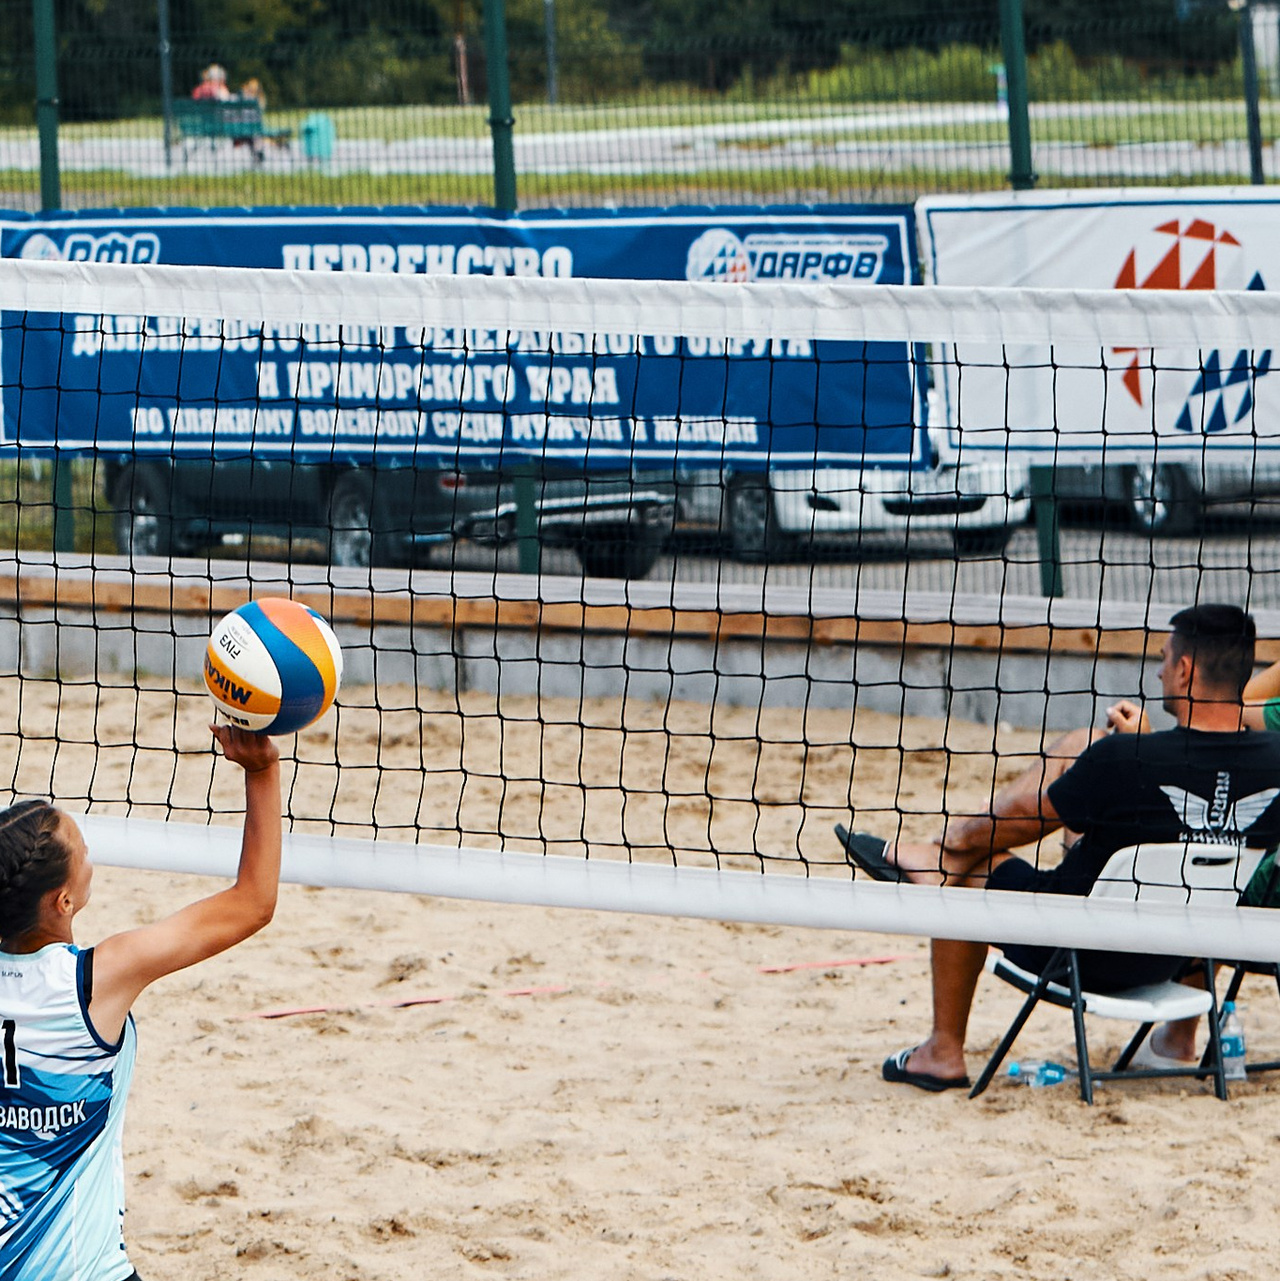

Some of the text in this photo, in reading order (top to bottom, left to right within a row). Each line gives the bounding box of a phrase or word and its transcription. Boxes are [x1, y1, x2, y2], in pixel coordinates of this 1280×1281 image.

[286, 361, 517, 403] ПРИМОРСКОГО
[525, 365, 620, 404] КРАЯ
[205, 652, 252, 705] MIKA
[0, 1018, 20, 1088] 1
